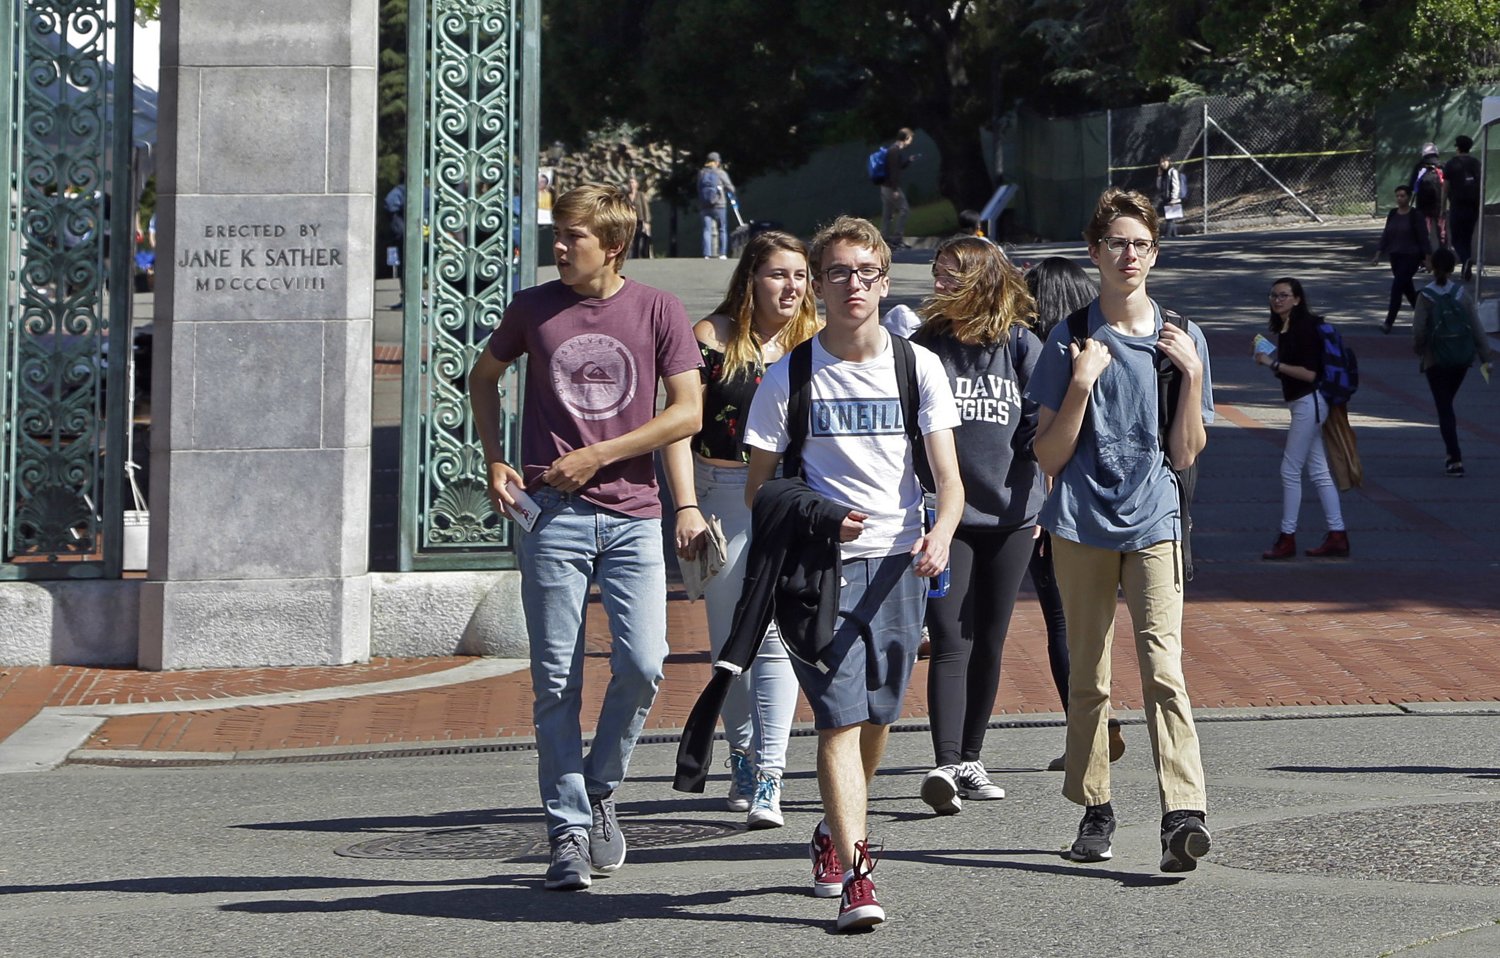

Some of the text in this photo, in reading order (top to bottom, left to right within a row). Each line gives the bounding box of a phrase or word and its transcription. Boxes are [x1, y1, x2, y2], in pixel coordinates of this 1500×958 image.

[204, 223, 321, 238] ERECTED BY
[178, 248, 343, 268] JANE K SATHER
[196, 277, 326, 292] MDCCCCVIIII
[552, 337, 615, 395] QUIKSILVER
[954, 374, 1022, 410] DAVIS
[817, 404, 903, 432] O'NEILL
